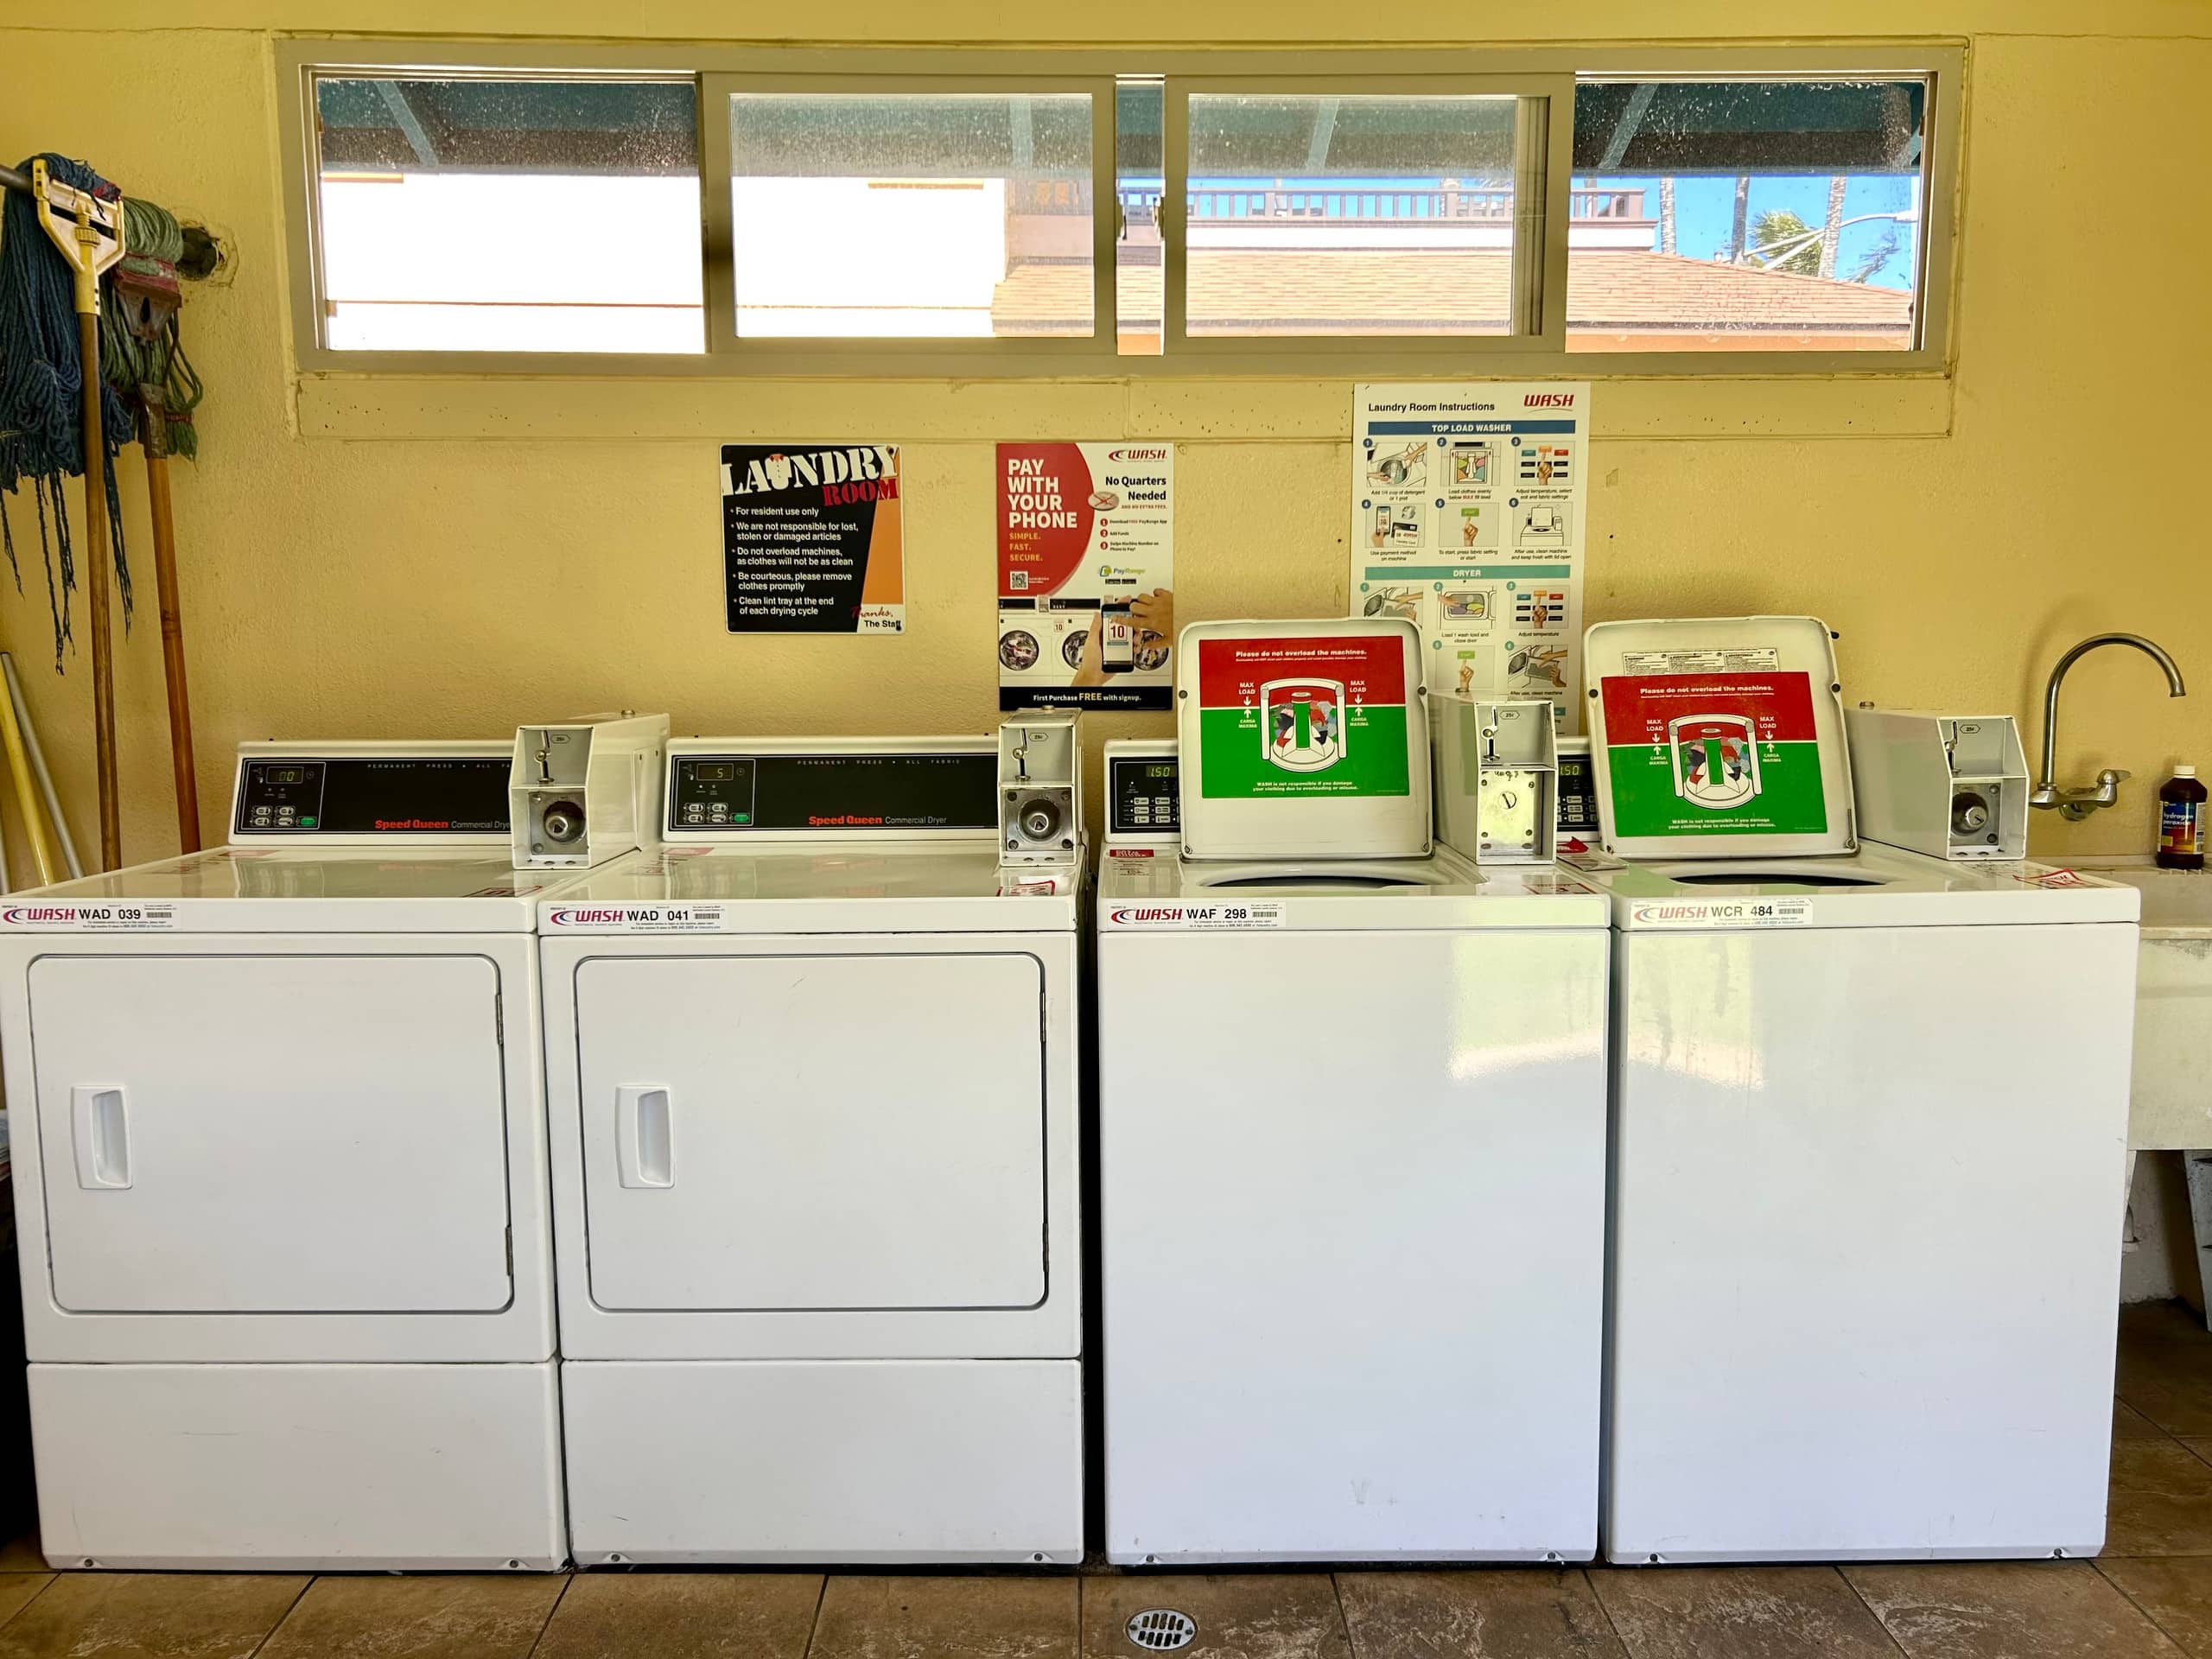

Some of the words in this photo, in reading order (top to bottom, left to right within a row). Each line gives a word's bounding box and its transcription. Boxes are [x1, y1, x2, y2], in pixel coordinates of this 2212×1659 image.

[1523, 394, 1574, 407] WASH
[1369, 403, 1407, 414] Laundry
[1409, 403, 1437, 411] Room
[1440, 402, 1495, 411] Instructions
[1128, 449, 1166, 459] WASH
[721, 446, 899, 496] LAUNDRY
[1008, 459, 1044, 475] PAY
[1007, 476, 1058, 493] WITH
[1105, 476, 1120, 486] No
[1121, 476, 1166, 488] Quarters
[822, 478, 899, 506] ROOM
[1128, 491, 1166, 500] Needed
[1007, 494, 1062, 511] YOUR
[735, 506, 749, 515] For
[751, 506, 784, 516] resident
[801, 507, 819, 518] only
[1009, 512, 1077, 529] PHONE
[735, 522, 749, 531] We
[765, 523, 779, 531] not
[780, 522, 827, 533] responsible
[828, 522, 840, 531] for
[841, 522, 859, 531] lost,
[736, 532, 762, 541] stolen
[773, 532, 811, 543] damaged
[812, 532, 842, 541] articles
[737, 547, 749, 556] Do
[765, 547, 800, 556] overload
[801, 547, 842, 556] machines,
[793, 557, 807, 566] not
[808, 557, 819, 566] be
[831, 557, 854, 566] clean
[795, 572, 822, 582] please
[738, 582, 768, 590] clothes
[769, 582, 805, 592] promptly
[739, 596, 762, 605] Clean
[763, 596, 776, 605] lint
[778, 597, 793, 607] tray
[749, 607, 769, 615] each
[770, 607, 797, 617] drying
[798, 607, 818, 617] cycle
[1110, 626, 1125, 639] 10
[375, 819, 411, 830] Speed
[412, 819, 449, 829] Queen
[809, 816, 845, 826] Speed
[846, 815, 883, 825] Queen
[885, 817, 926, 825] Commercial
[927, 817, 947, 826] Dryer
[28, 908, 75, 920] WASH
[79, 909, 111, 919] WAD
[118, 909, 141, 919] 039
[575, 910, 624, 922] WASH
[626, 911, 659, 921] WAD
[667, 910, 688, 921] 041
[1135, 908, 1183, 920] WASH
[1186, 908, 1217, 919] WAF
[1224, 908, 1247, 919] 298
[1659, 907, 1707, 918] WASH
[1711, 906, 1743, 917] WCR
[1751, 906, 1773, 917] 484
